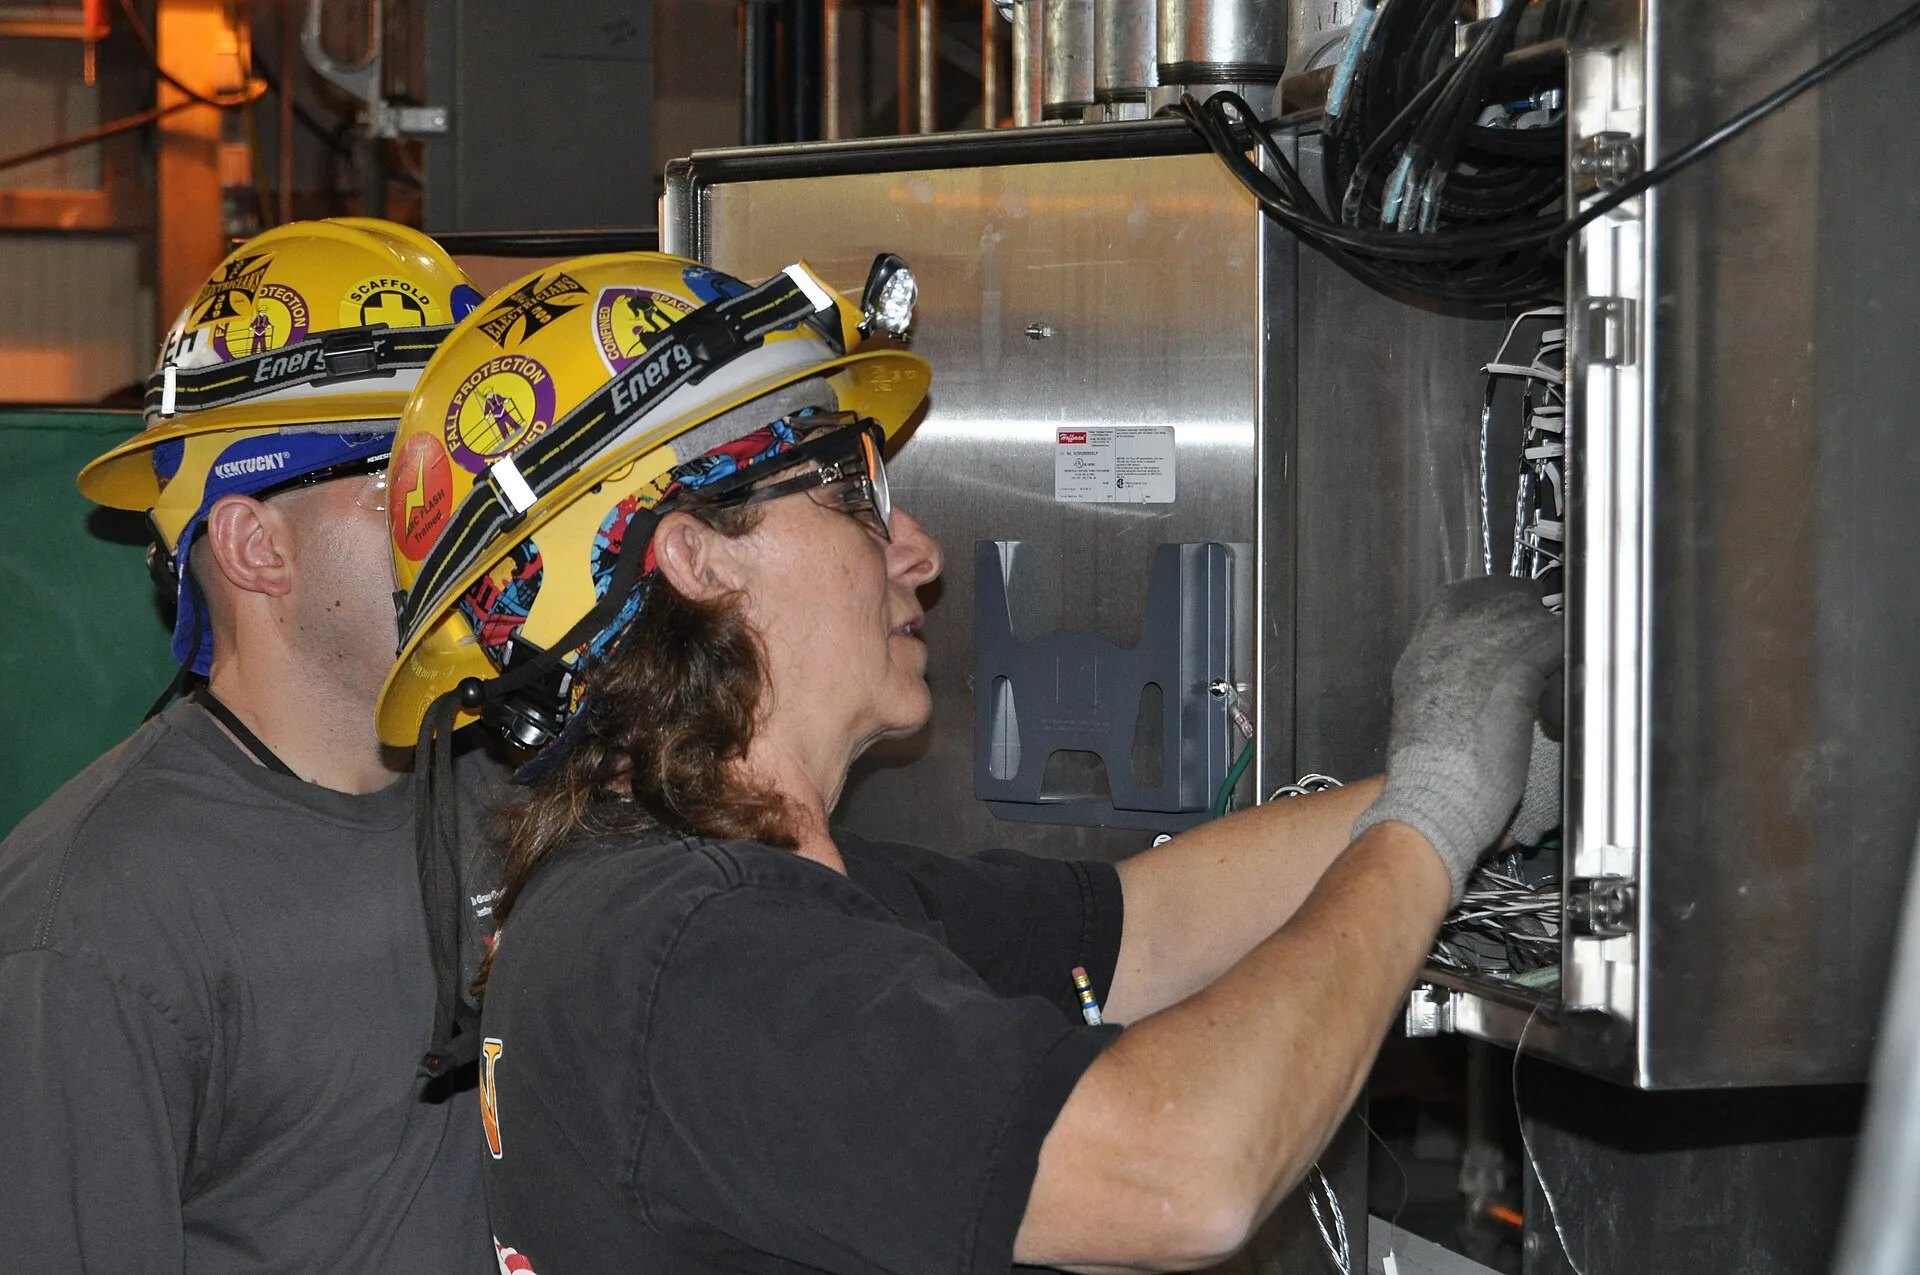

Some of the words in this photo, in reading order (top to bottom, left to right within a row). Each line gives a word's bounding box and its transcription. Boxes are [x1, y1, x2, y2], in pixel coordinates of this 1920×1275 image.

[258, 286, 307, 328] OTECTION
[350, 278, 430, 306] SCAFFOLD
[599, 306, 620, 360] CONFINED
[254, 348, 327, 383] Energ
[610, 344, 693, 416] Energ
[446, 409, 461, 453] FALL
[456, 358, 546, 408] PROTECTION
[420, 488, 446, 519] FLASH
[414, 509, 443, 543] Trained
